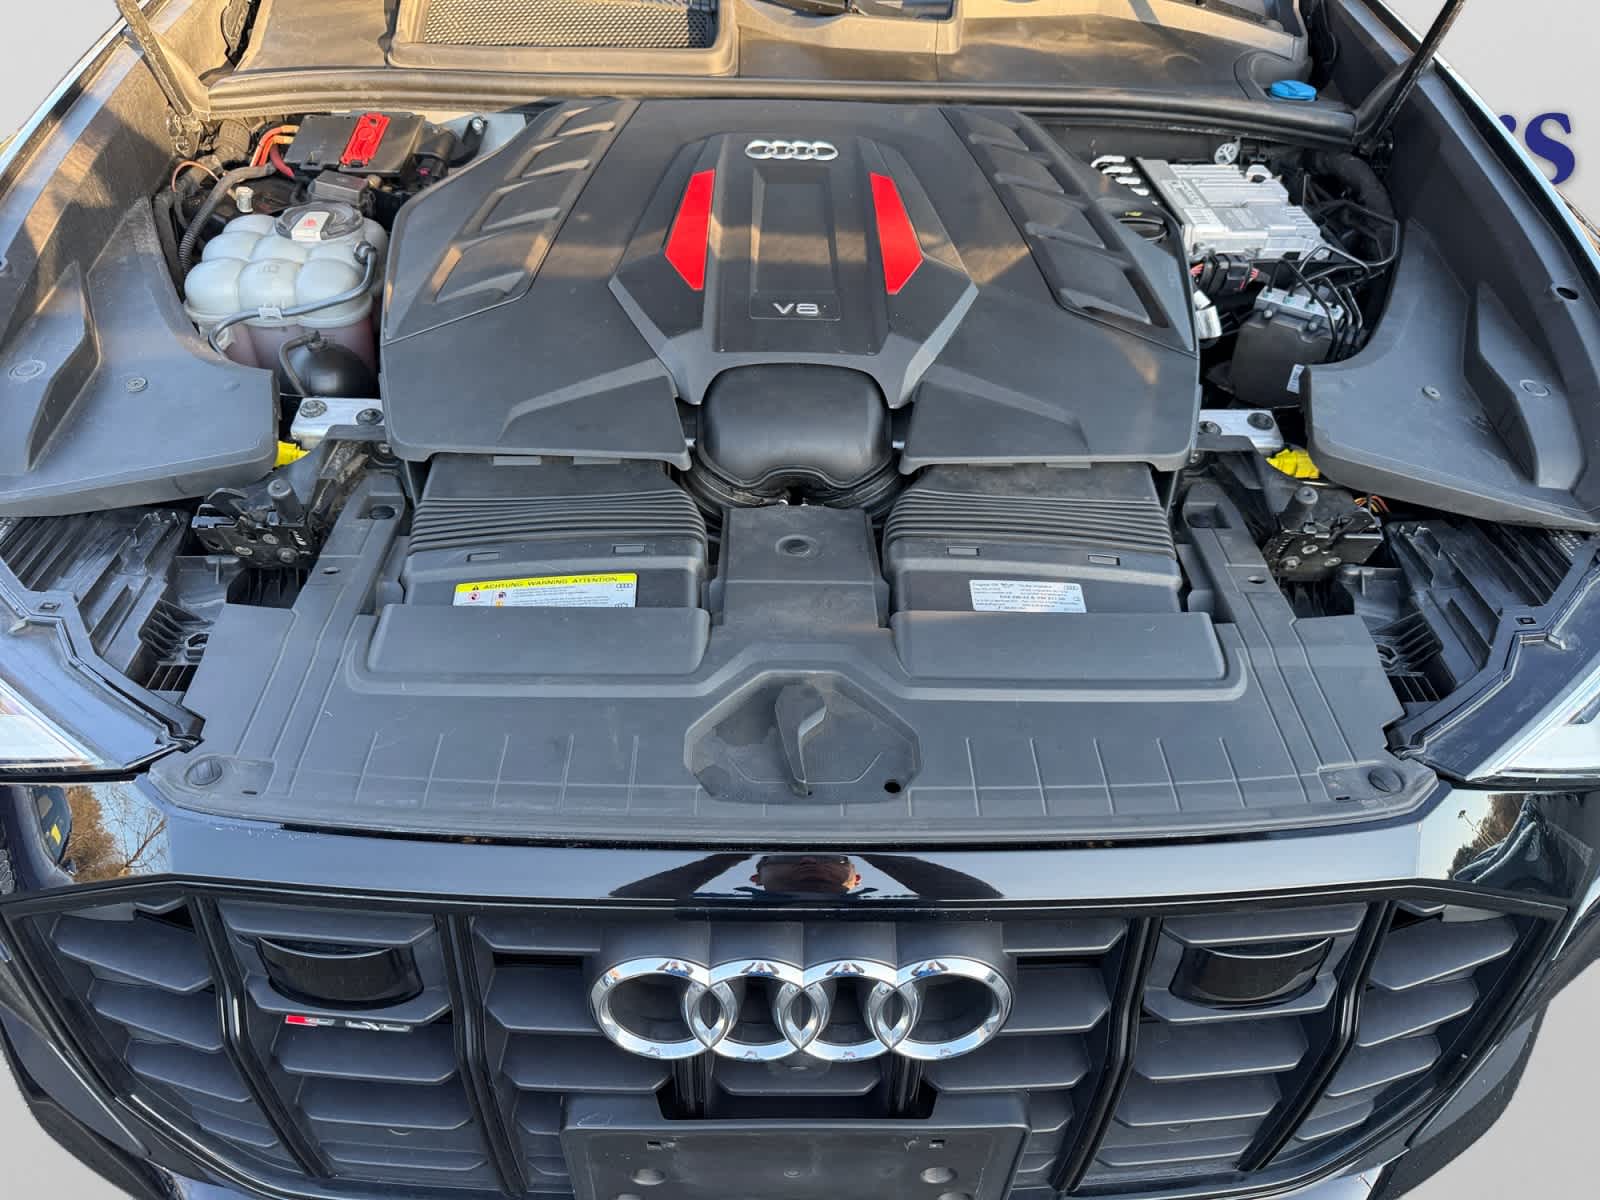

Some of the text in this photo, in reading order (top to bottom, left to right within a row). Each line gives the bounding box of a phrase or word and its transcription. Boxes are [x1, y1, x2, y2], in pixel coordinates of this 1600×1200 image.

[772, 302, 819, 316] V8
[483, 575, 618, 590] ACHTUNG WARNING ATTENTION
